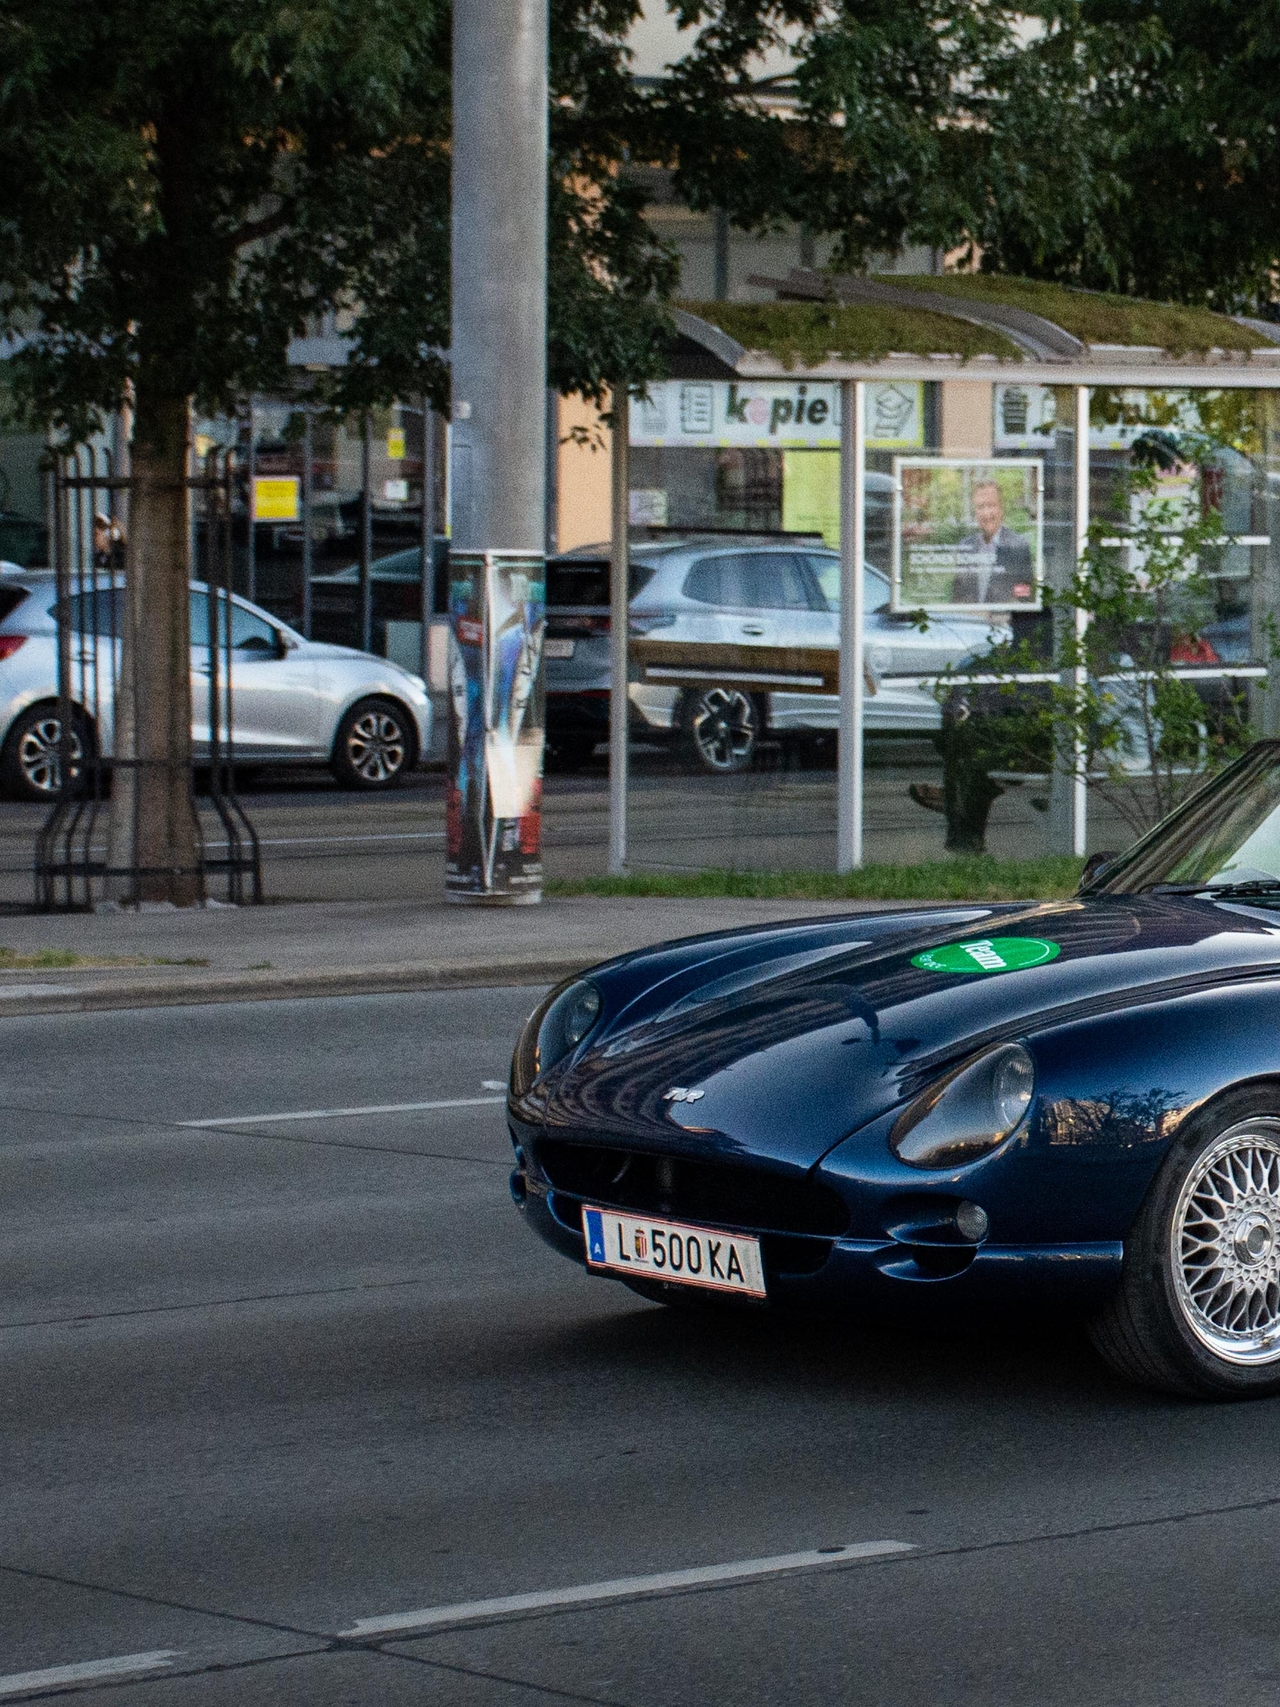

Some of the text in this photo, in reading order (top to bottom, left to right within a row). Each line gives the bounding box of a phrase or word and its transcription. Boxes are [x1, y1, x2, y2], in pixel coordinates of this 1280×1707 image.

[618, 1222, 746, 1283] L 500 KA
